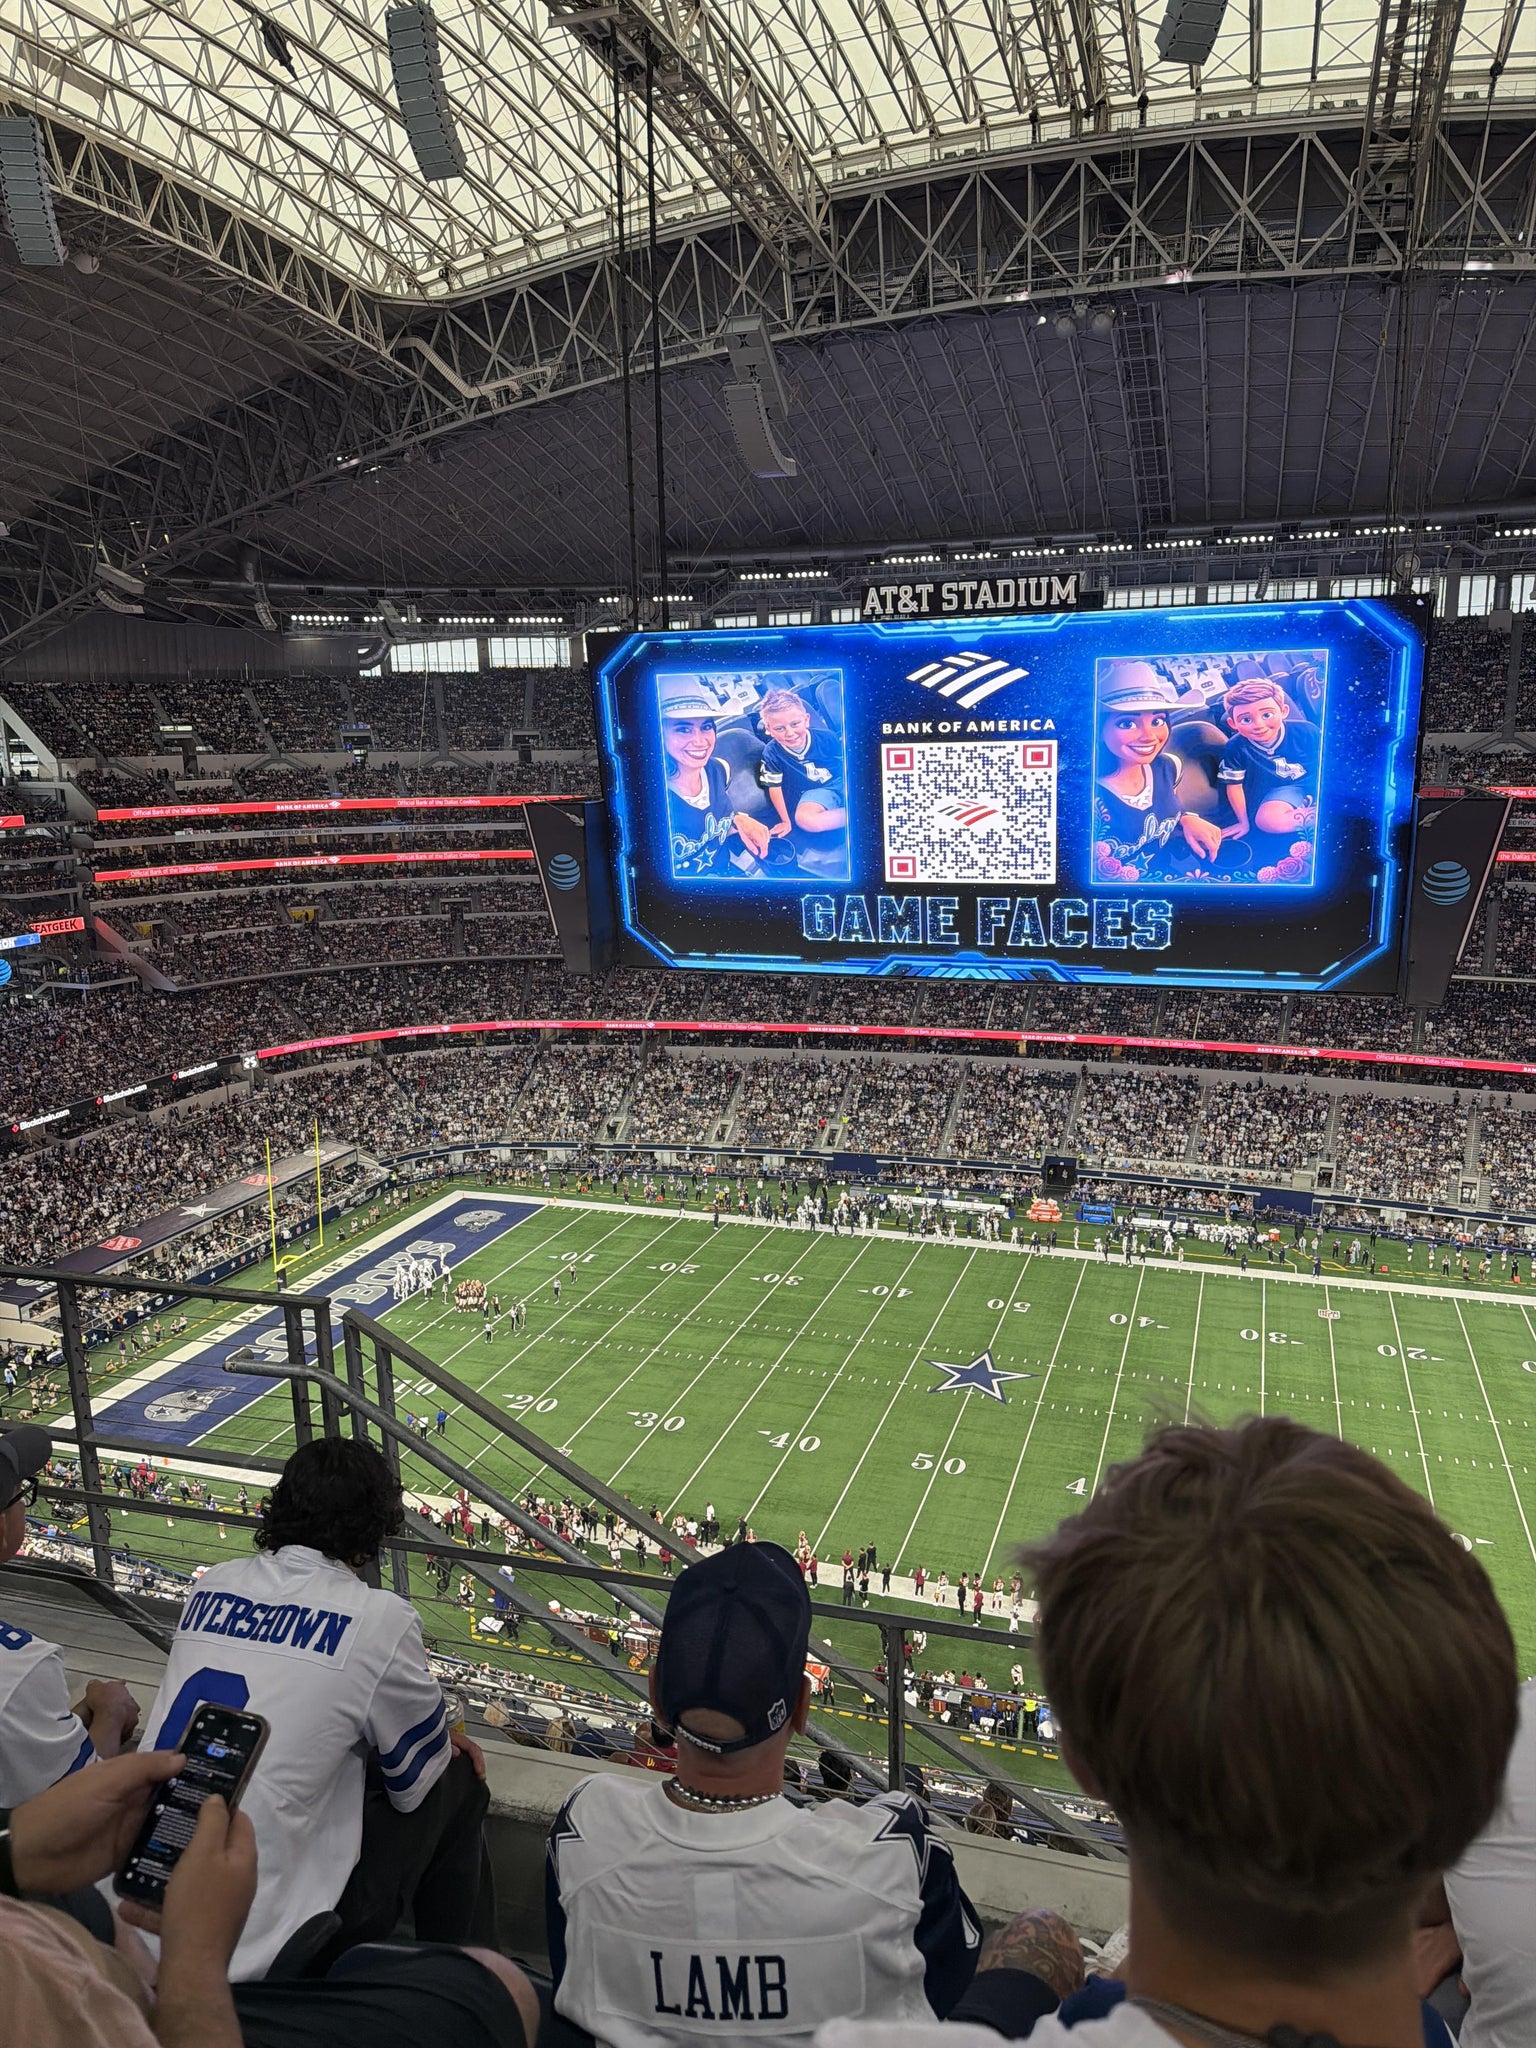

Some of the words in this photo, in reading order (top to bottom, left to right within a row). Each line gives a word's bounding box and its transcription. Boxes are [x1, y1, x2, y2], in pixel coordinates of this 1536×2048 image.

[863, 583, 934, 616] AT&T
[942, 575, 1077, 612] STADIUM
[882, 721, 933, 734] BANK
[938, 721, 962, 734] OF
[966, 719, 1056, 732] AMERICA
[802, 894, 960, 945] GAME
[976, 897, 1173, 950] FACES
[20, 1109, 70, 1130] Blockchain.com
[321, 1263, 346, 1273] OF
[348, 1249, 369, 1260] US
[910, 1453, 967, 1474] 50
[1065, 1477, 1088, 1495] 4
[180, 1590, 352, 1656] OVERSHOWN
[650, 1951, 788, 2020] LAMB
